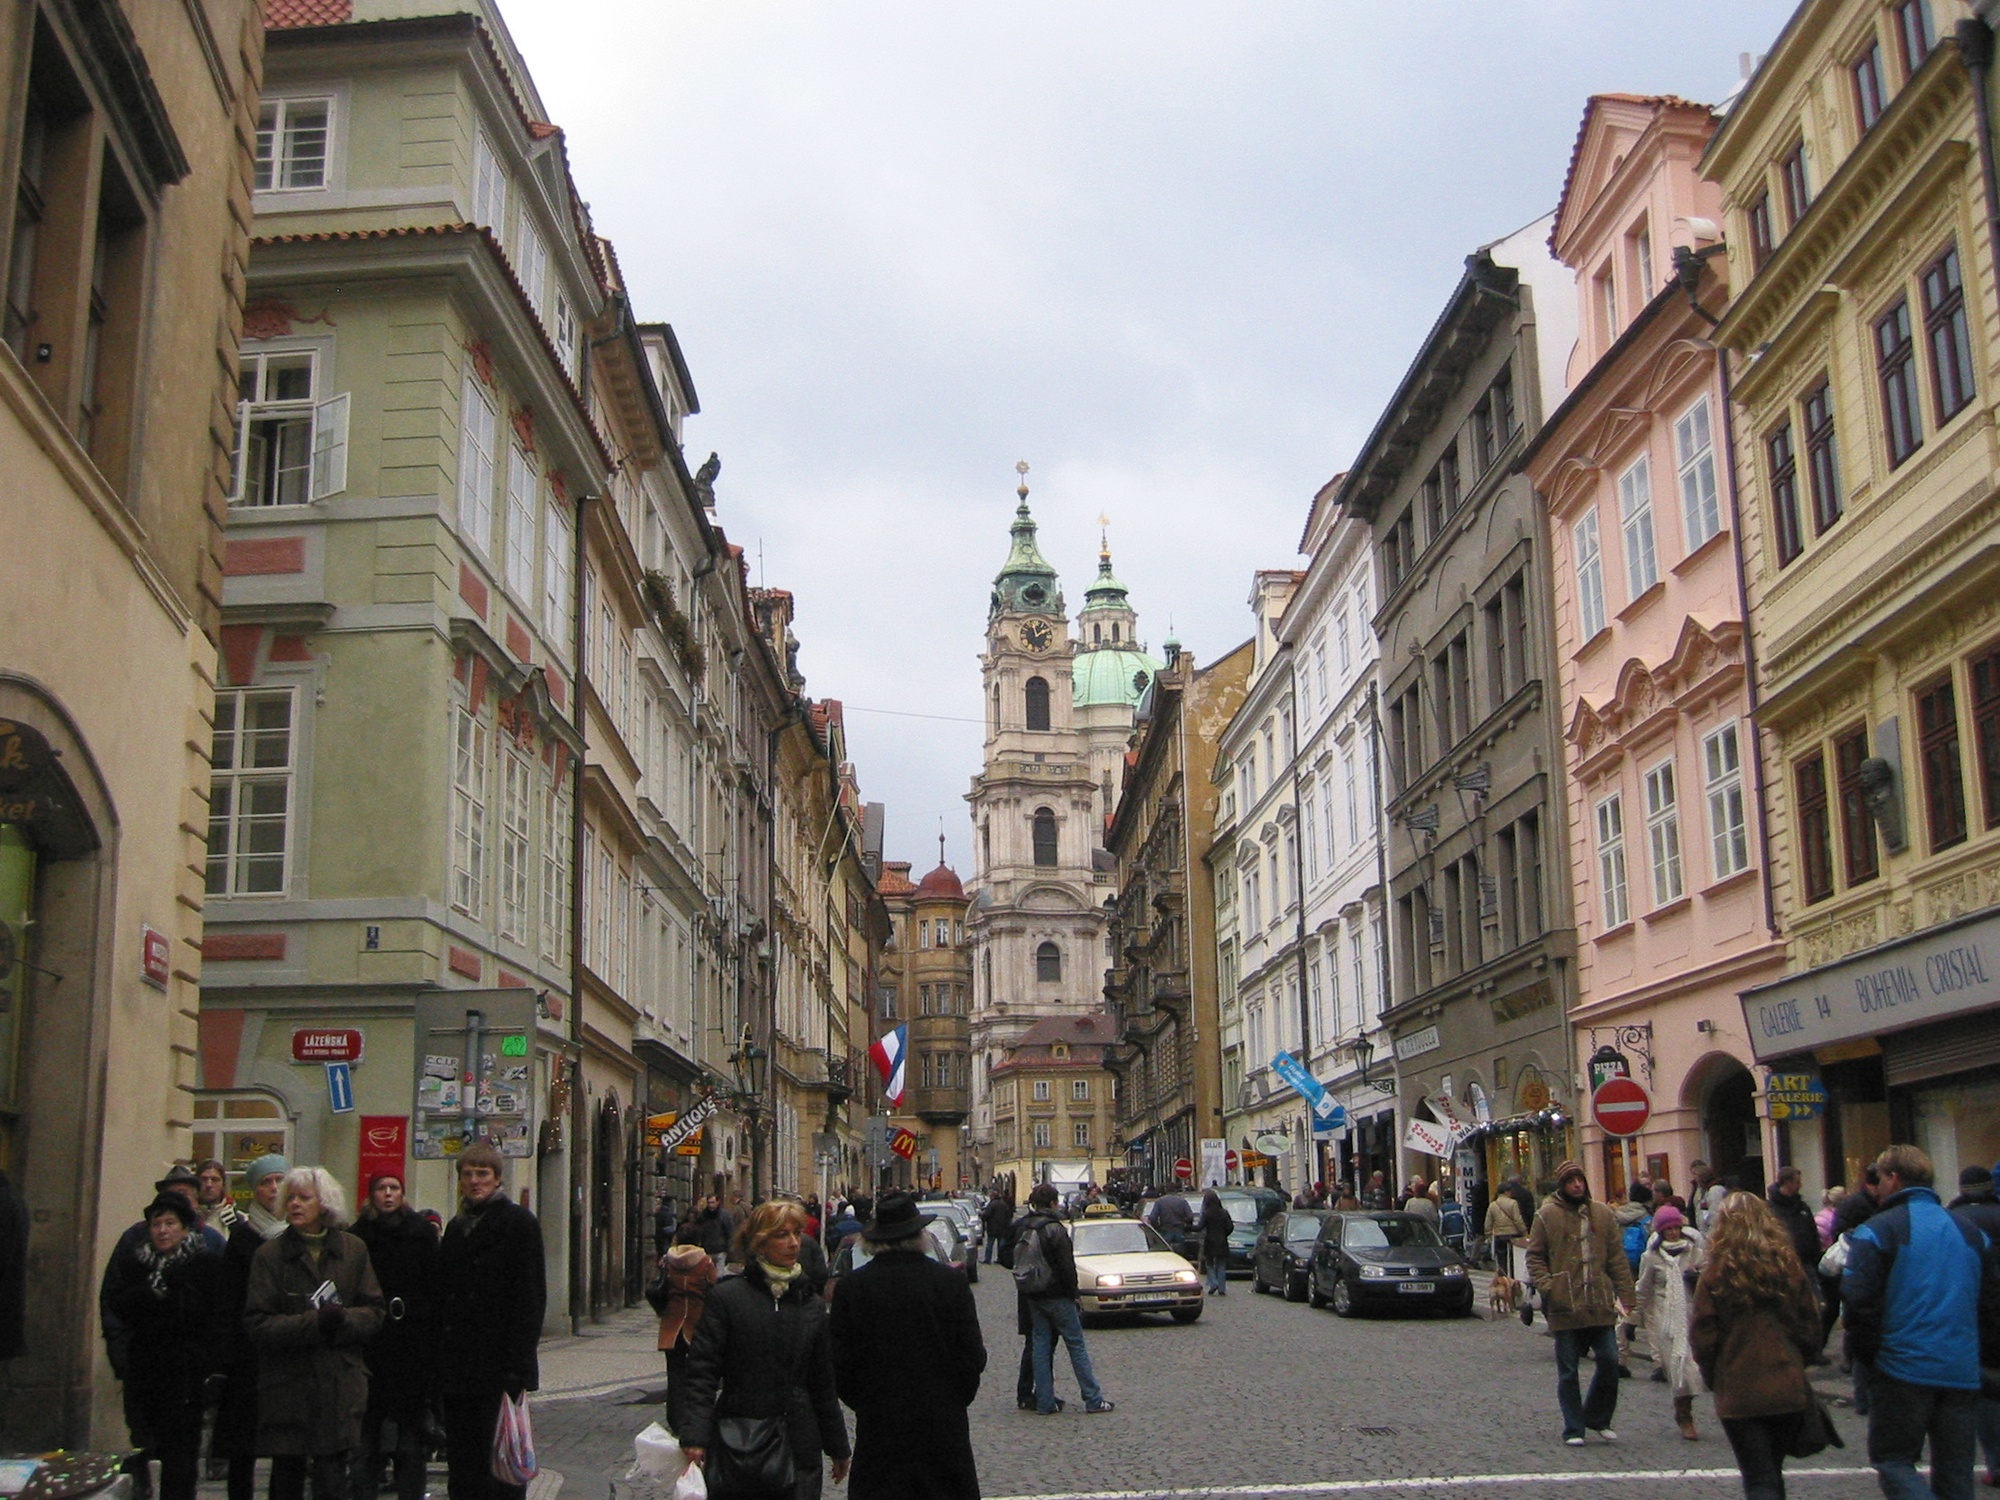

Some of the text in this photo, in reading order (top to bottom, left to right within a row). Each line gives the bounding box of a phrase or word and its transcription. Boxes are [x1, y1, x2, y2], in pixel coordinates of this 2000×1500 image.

[1760, 944, 1989, 1038] GALERIE 14 BOHEMIA CRISTAL
[305, 1034, 348, 1047] LÁZEŇSKÁ
[1593, 1061, 1624, 1075] PIZZA
[1767, 1075, 1811, 1092] ART
[1767, 1093, 1824, 1103] GALERIE
[1456, 1121, 1476, 1139] WAX
